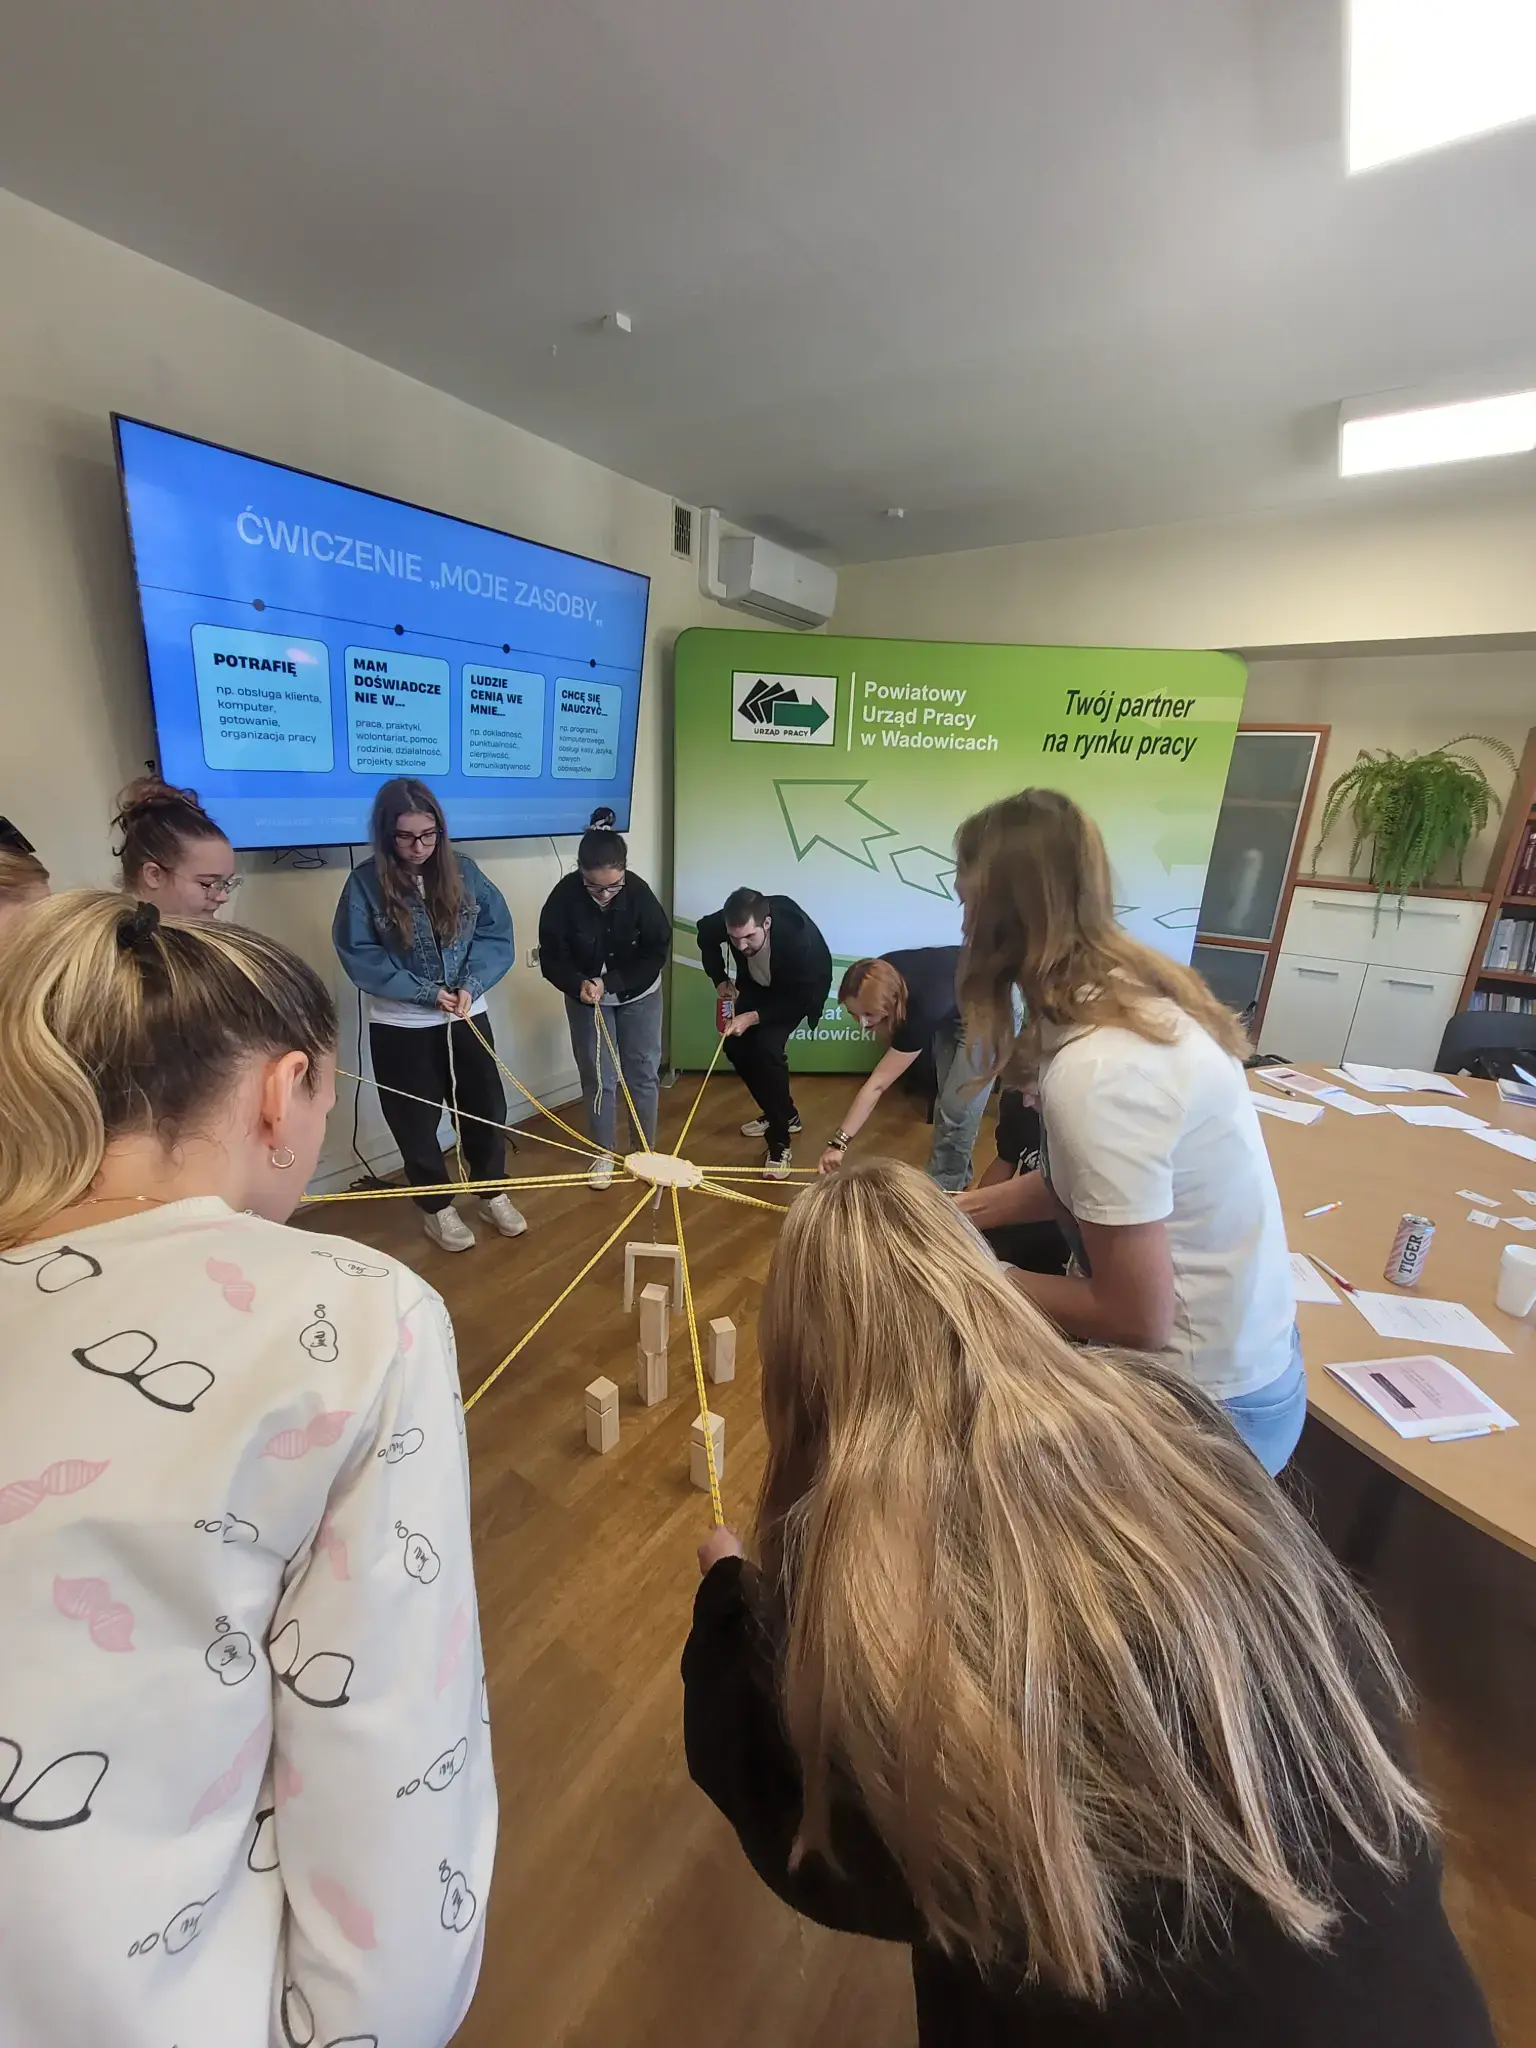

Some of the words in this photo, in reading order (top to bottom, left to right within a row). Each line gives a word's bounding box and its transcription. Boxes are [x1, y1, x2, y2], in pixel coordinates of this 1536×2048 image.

[237, 505, 422, 582] ĆWICZENIE
[213, 653, 297, 677] POTRAFIĘ
[353, 658, 388, 673] MAM
[354, 675, 442, 695] DOŚWIADCZE
[470, 674, 508, 688] LUDZIE
[216, 686, 235, 696] np.
[237, 687, 282, 700] obsługa
[285, 691, 322, 704] klienta,
[354, 691, 378, 705] NIE
[470, 689, 504, 704] CENIĄ
[507, 694, 523, 704] WE
[561, 690, 586, 703] CHCĘ
[587, 693, 601, 706] SIĘ
[864, 681, 967, 706] Powiatowy
[217, 699, 277, 713] komputer,
[1066, 690, 1115, 723] Twój
[1115, 693, 1195, 723] partner
[219, 715, 281, 728] gotowanie,
[355, 720, 384, 730] praca,
[862, 705, 917, 728] Urząd
[922, 708, 976, 731] Pracy
[220, 730, 285, 742] organizacja
[288, 733, 317, 744] pracy
[410, 736, 438, 745] pomoc
[754, 728, 780, 737] URZĄD
[783, 729, 808, 738] PRACY
[861, 732, 876, 746] w
[882, 730, 998, 751] Wadowicach
[1042, 733, 1068, 752] na
[1073, 729, 1134, 760] rynku
[1135, 735, 1198, 762] pracy
[357, 757, 393, 767] projekty
[395, 758, 426, 767] szkolne
[789, 1027, 876, 1041] adowicki
[1398, 1234, 1424, 1274] TIGER
